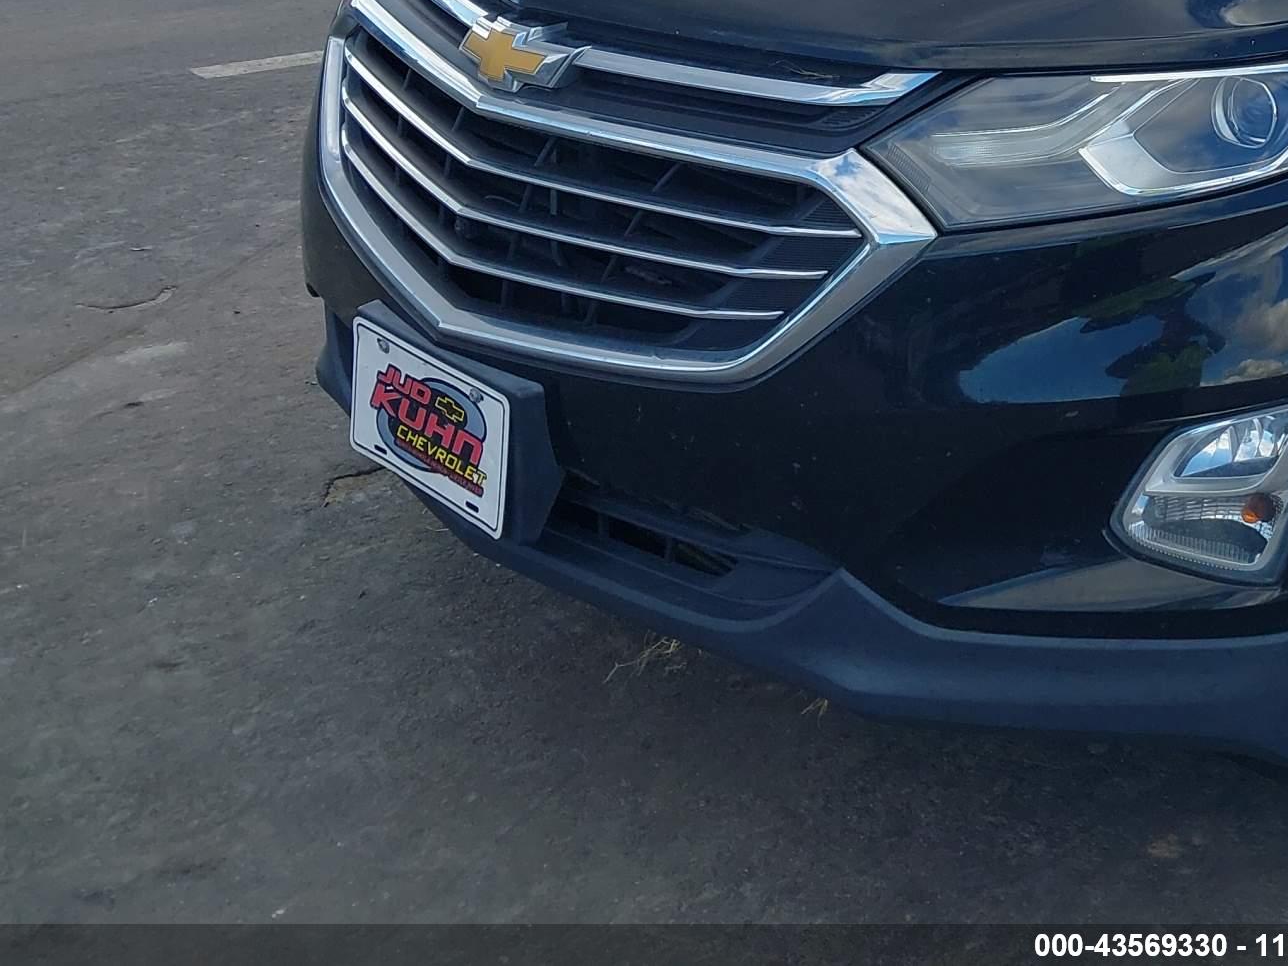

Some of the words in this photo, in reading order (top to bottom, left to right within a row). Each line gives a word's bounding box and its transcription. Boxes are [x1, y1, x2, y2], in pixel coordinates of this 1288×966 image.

[377, 364, 432, 404] JUD
[371, 384, 484, 464] KUHN
[397, 425, 487, 486] CHEVROLET
